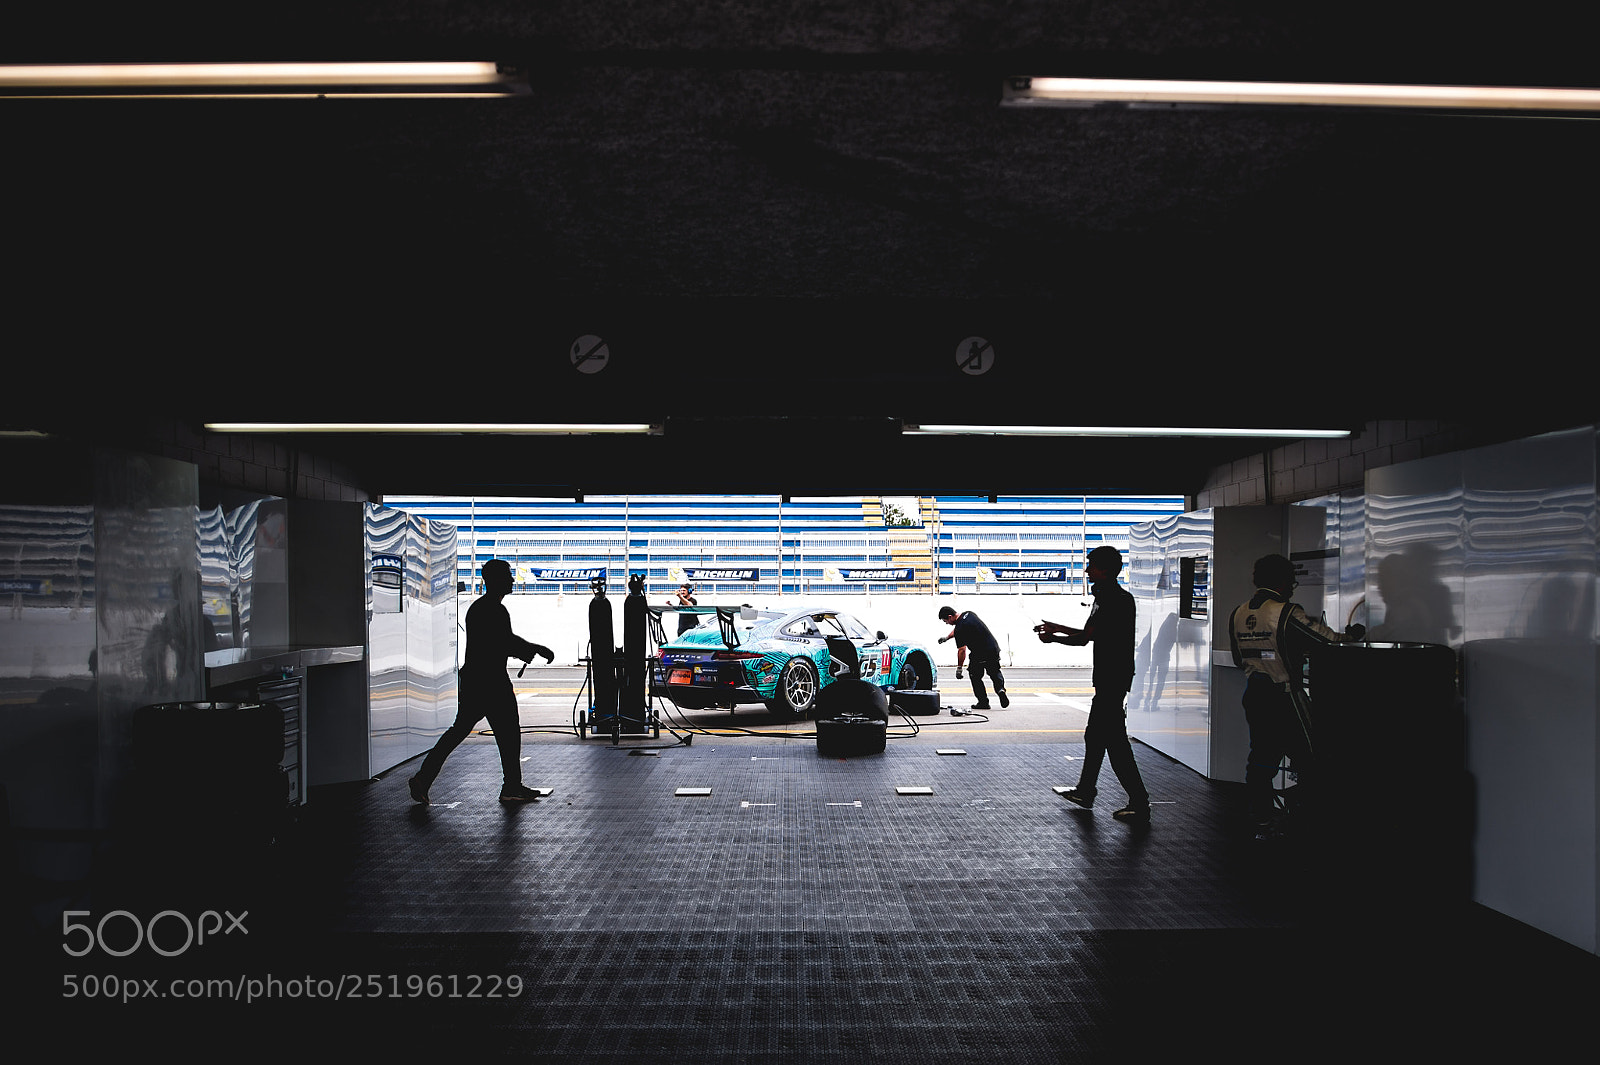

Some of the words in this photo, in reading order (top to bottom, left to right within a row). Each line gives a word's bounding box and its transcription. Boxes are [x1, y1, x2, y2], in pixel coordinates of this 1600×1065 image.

[540, 569, 600, 578] MICHELIN
[693, 570, 753, 578] MICHELIN
[848, 570, 908, 578] MICHELIN
[1000, 570, 1060, 578] MICHELIN
